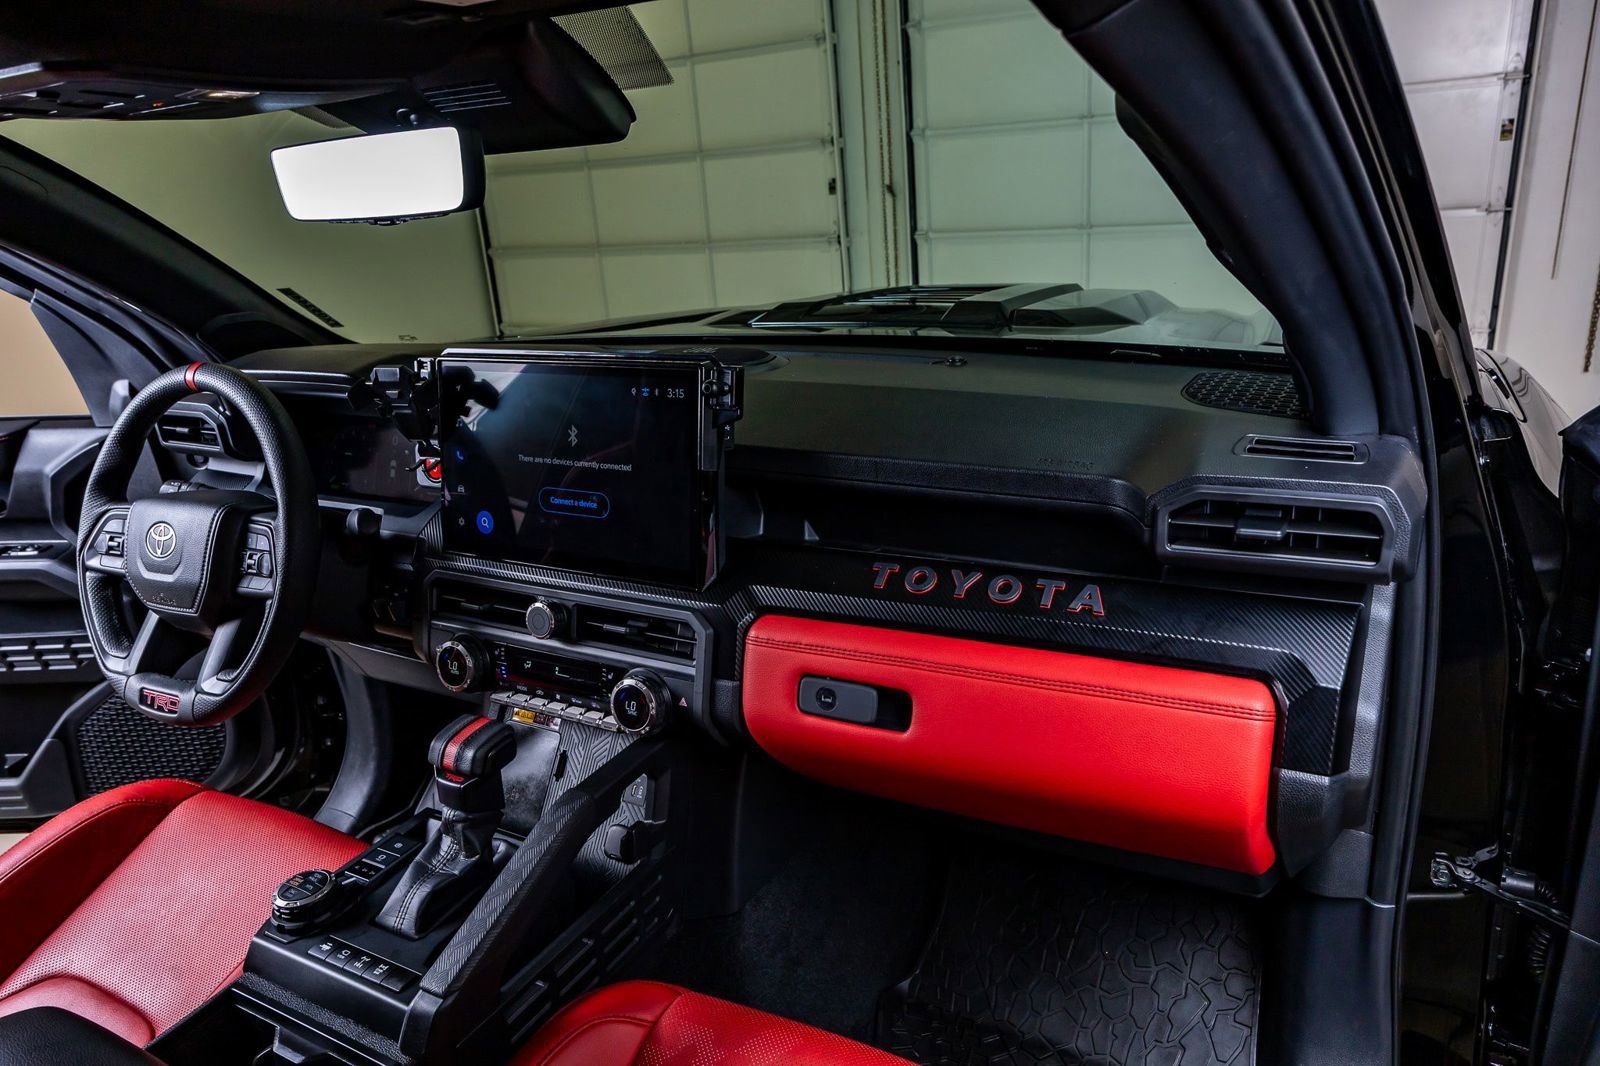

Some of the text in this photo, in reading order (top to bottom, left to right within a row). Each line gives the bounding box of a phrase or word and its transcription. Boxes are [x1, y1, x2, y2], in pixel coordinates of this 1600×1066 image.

[666, 388, 684, 398] 3:15
[518, 454, 534, 462] There
[552, 457, 574, 466] devices
[574, 460, 600, 470] currently
[600, 462, 632, 471] connected
[550, 496, 574, 506] Connect
[579, 500, 598, 508] device
[872, 562, 1105, 616] TOYOTA
[142, 689, 180, 712] TRD
[625, 700, 637, 710] LO
